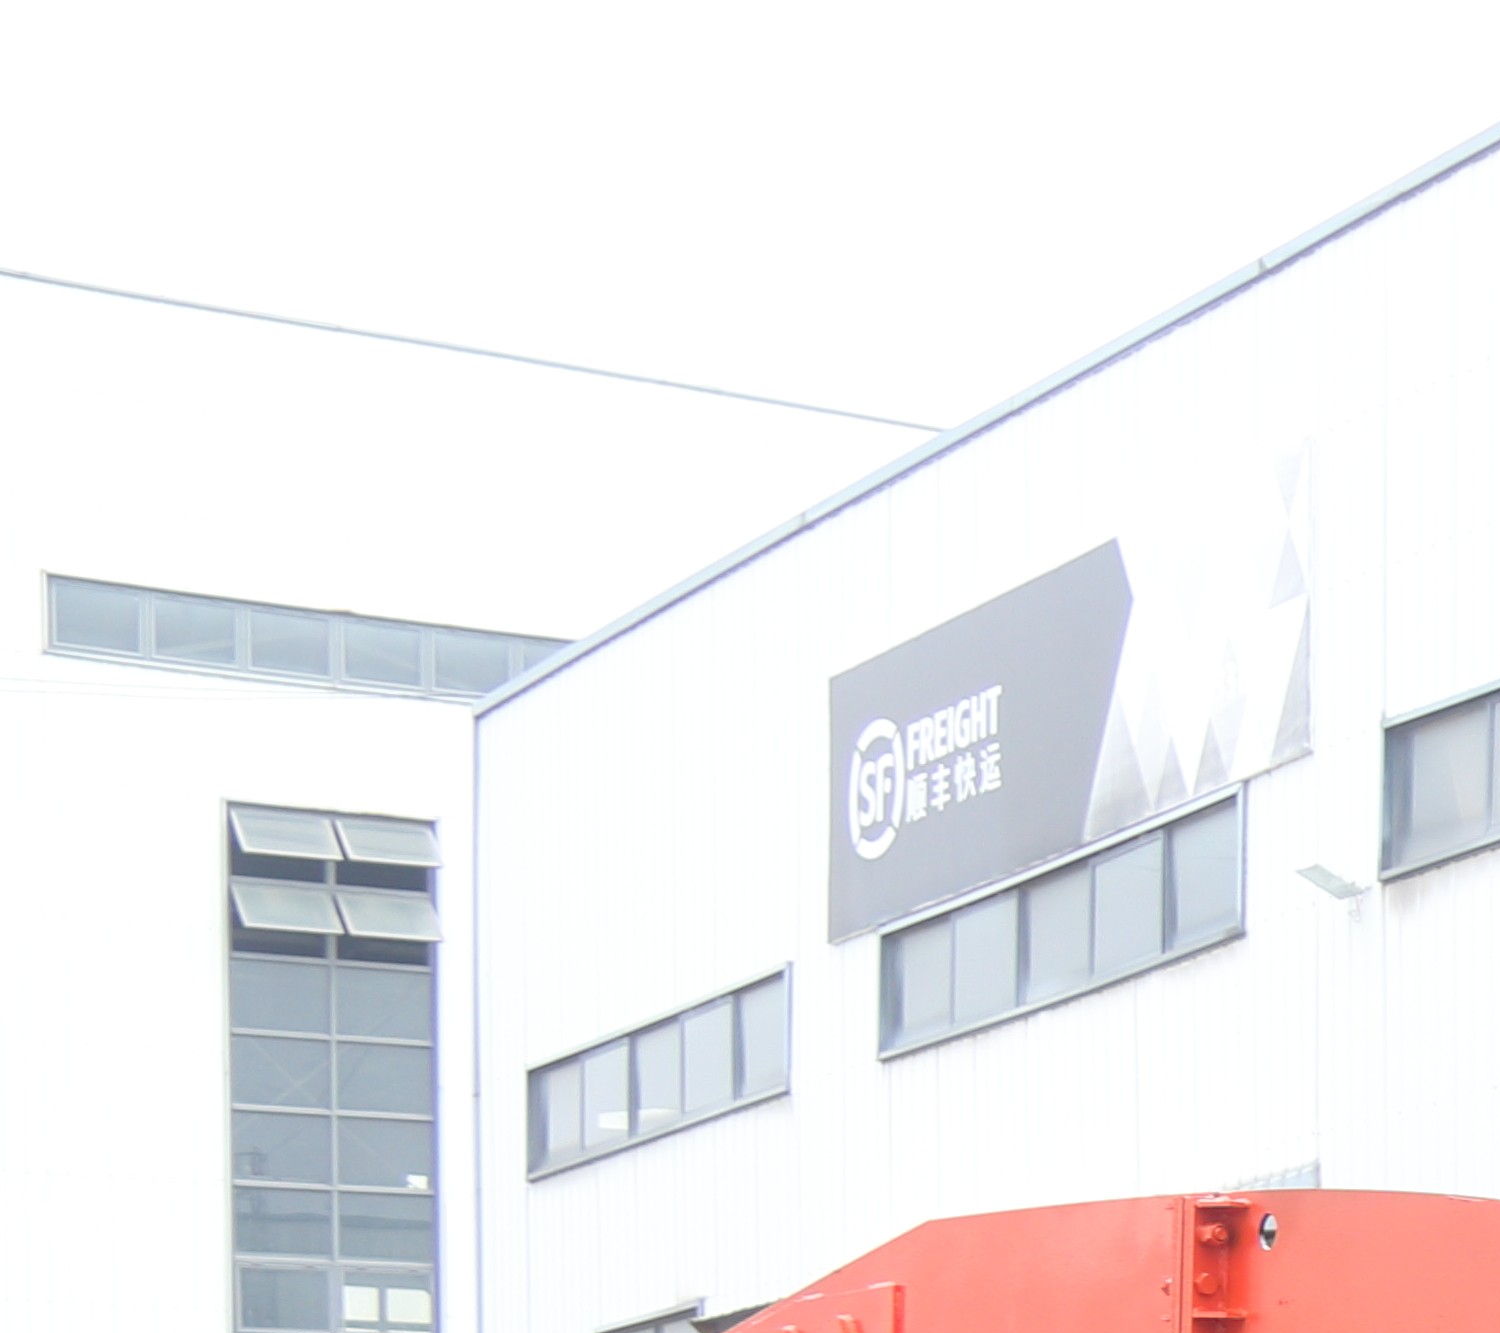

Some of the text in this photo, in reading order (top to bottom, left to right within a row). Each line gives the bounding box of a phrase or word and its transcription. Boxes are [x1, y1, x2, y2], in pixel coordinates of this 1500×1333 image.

[907, 685, 1003, 770] FREIGHT
[860, 753, 893, 827] SF
[905, 742, 1002, 824] 顺丰快运
